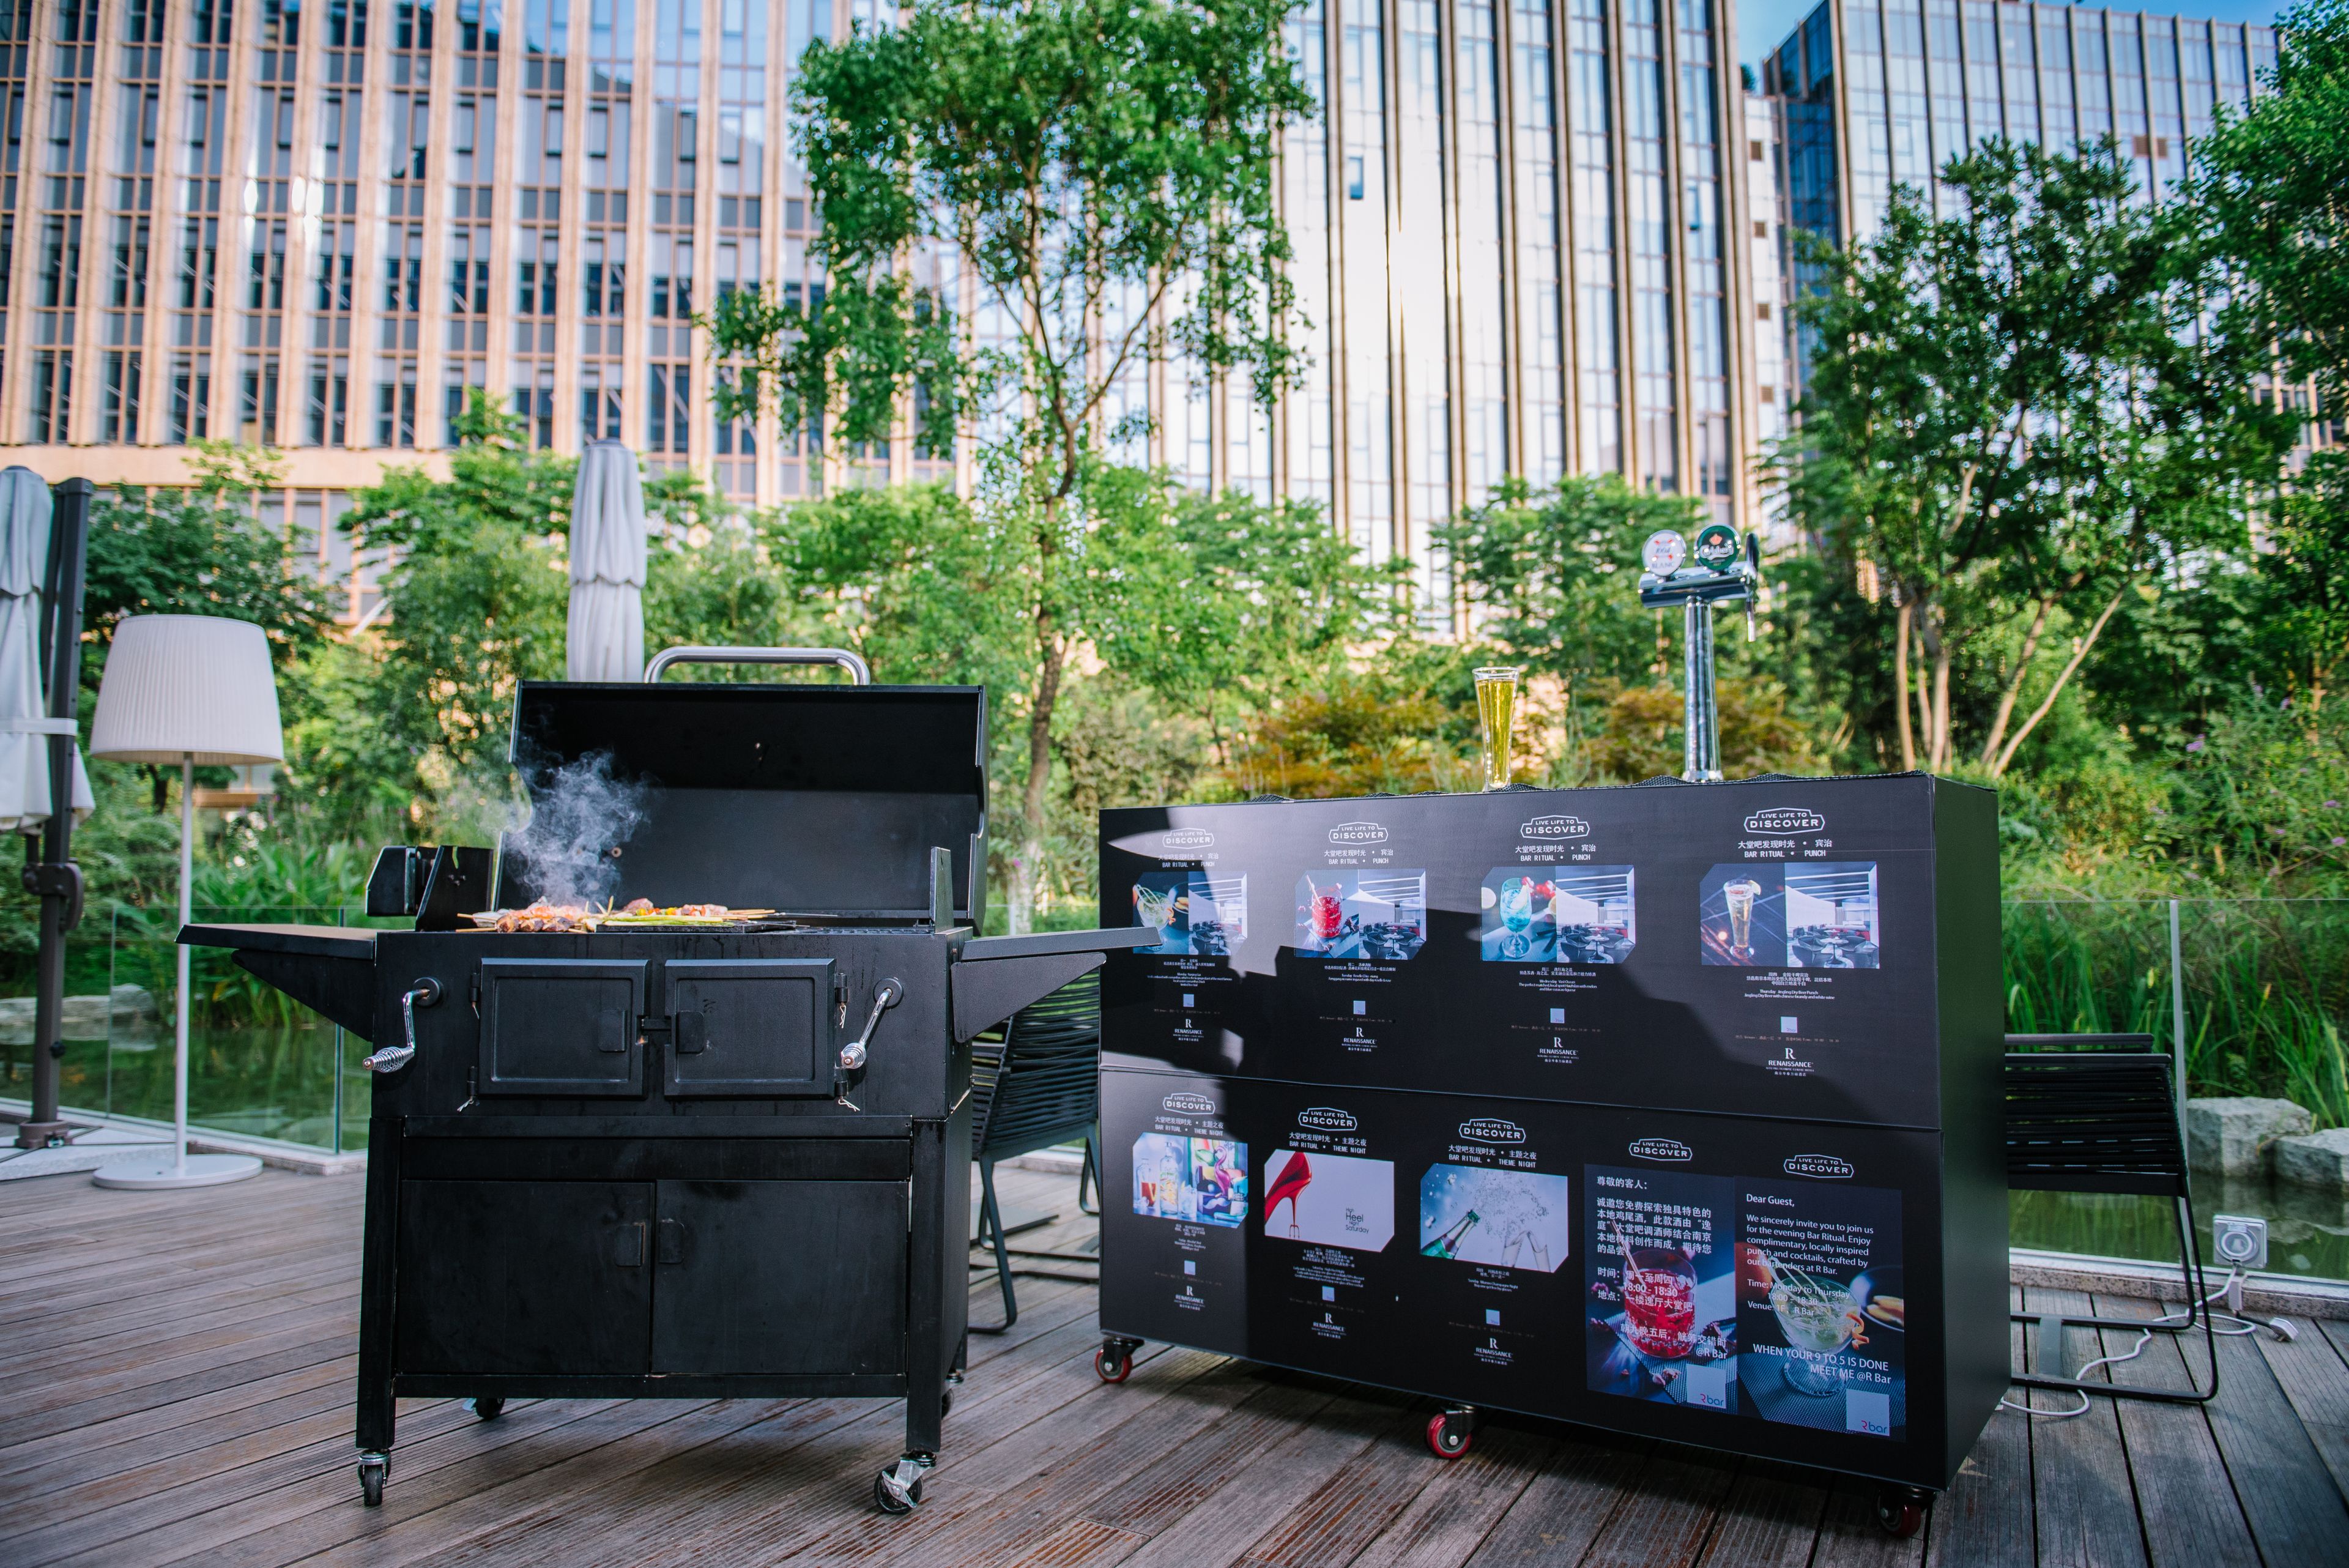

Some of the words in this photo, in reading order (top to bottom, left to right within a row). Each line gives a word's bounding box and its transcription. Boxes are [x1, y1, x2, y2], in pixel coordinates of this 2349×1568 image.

[1750, 819, 1819, 828] DISCOVER
[1515, 845, 1564, 853] 大堂吧发现时光
[1738, 840, 1795, 849] 大堂吧发现时光
[1785, 1047, 1796, 1060] R
[1167, 1101, 1211, 1111] DISCOVER
[1302, 1116, 1353, 1126] DISCOVER
[1464, 1128, 1521, 1139] DISCOVER
[1449, 1145, 1496, 1156] 大堂吧发现时光
[1509, 1150, 1537, 1160] 主题之夜
[1633, 1146, 1688, 1157] DISCOVER
[1789, 1163, 1848, 1174] DISCOVER
[1746, 1194, 1766, 1203] Dear
[1768, 1196, 1795, 1207] Guest,
[1597, 1197, 1711, 1219] 诚邀您免费探索独具特色的
[1346, 1212, 1364, 1222] Heel
[1345, 1225, 1370, 1234] Saturday
[1761, 1216, 1794, 1227] sincerely
[1796, 1219, 1818, 1228] invite
[1846, 1224, 1862, 1233] join
[1759, 1225, 1772, 1235] the
[1774, 1229, 1805, 1239] evening
[1822, 1233, 1846, 1243] Ritual.
[1849, 1235, 1871, 1246] Enjoy
[1746, 1237, 1808, 1250] complimentary,
[1809, 1242, 1835, 1254] locally
[1836, 1245, 1869, 1256] inspired
[1773, 1250, 1788, 1258] and
[1790, 1252, 1826, 1263] cocktails,
[1827, 1255, 1856, 1266] crafted
[1858, 1258, 1868, 1268] by
[1762, 1259, 1805, 1271] bartenders
[1823, 1266, 1838, 1275] Bar.
[1624, 1282, 1647, 1293] 18:00
[1655, 1286, 1678, 1298] 18:30
[1748, 1279, 1768, 1289] Time:
[1770, 1282, 1802, 1294] Monday
[1813, 1287, 1850, 1299] Thursday
[1767, 1293, 1788, 1302] 18:00
[1748, 1301, 1773, 1311] Venue:
[1475, 1347, 1512, 1358] RENAISSANCE
[1696, 1348, 1710, 1358] @R
[1713, 1349, 1727, 1359] Bar
[1753, 1343, 1783, 1356] WHEN
[1785, 1348, 1812, 1360] YOUR
[1814, 1351, 1821, 1361] 9
[1824, 1353, 1837, 1364] TO
[1839, 1356, 1845, 1365] 5
[1848, 1357, 1857, 1367] IS
[1859, 1359, 1888, 1371] DONE
[1810, 1364, 1837, 1375] MEET
[1839, 1368, 1854, 1379] ME
[1857, 1372, 1872, 1381] @R
[1875, 1373, 1891, 1384] Bar
